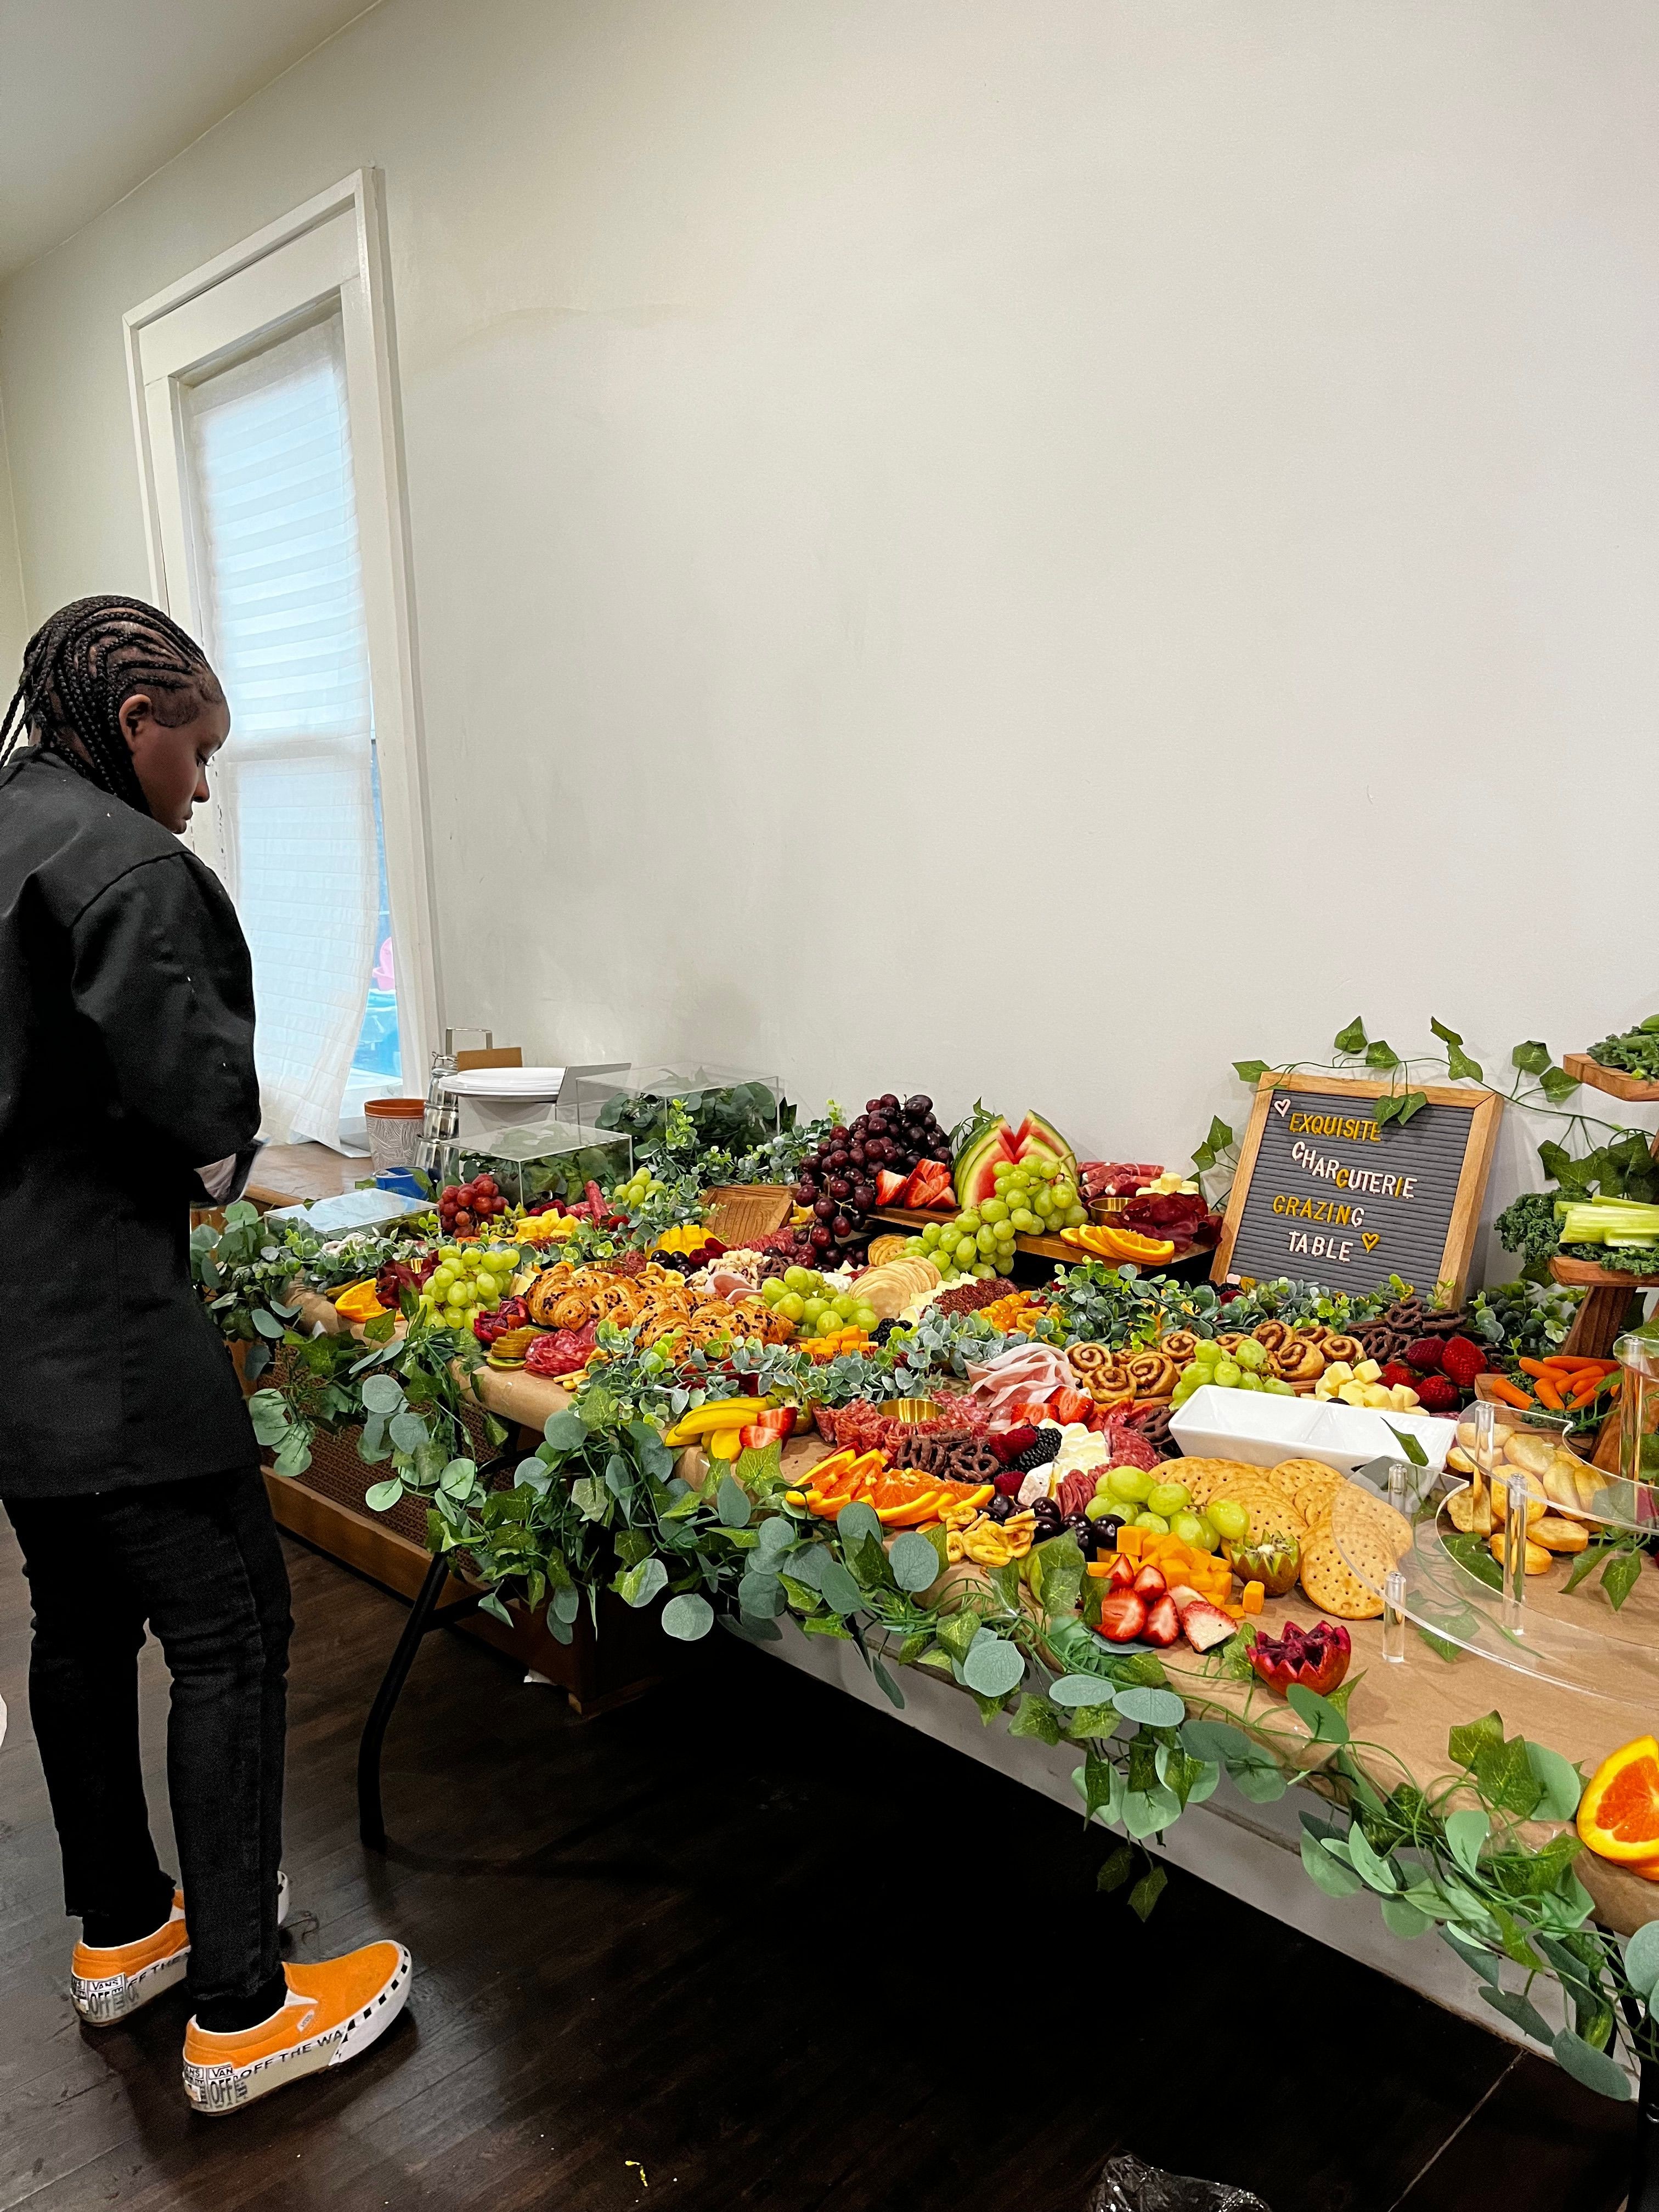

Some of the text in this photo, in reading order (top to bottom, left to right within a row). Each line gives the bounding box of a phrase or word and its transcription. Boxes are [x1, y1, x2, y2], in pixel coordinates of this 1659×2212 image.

[1289, 1113, 1381, 1142] EXQUISITE
[1291, 1141, 1418, 1199] CHARCUTERIE
[1273, 1195, 1365, 1228] GRAZING
[1288, 1231, 1353, 1262] TABLE
[92, 1979, 119, 1991] VANS
[240, 2058, 274, 2079] OFF
[279, 2042, 312, 2063] THE
